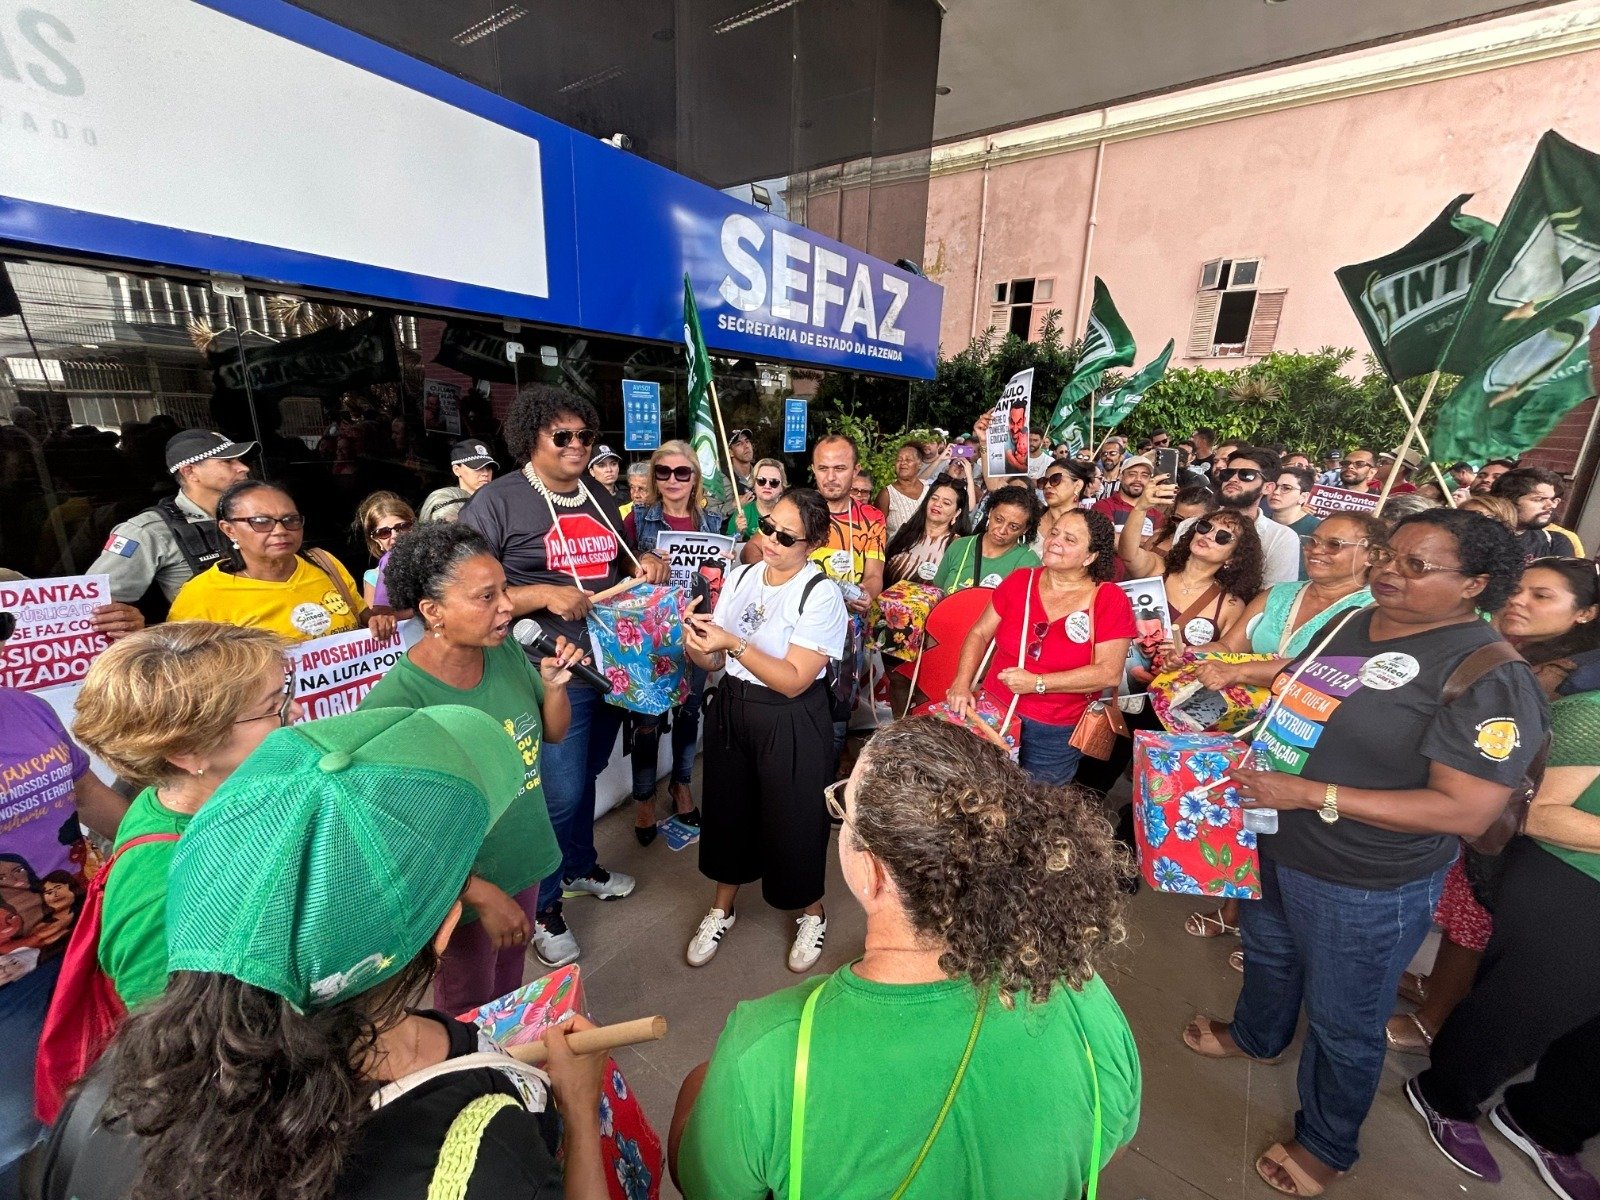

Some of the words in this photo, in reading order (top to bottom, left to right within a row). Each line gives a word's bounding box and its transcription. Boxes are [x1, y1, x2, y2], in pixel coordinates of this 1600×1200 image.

[719, 213, 909, 346] SEFAZ
[718, 314, 798, 343] SECRETARIA
[800, 331, 814, 346] DE
[815, 335, 854, 352] ESTADO
[854, 343, 866, 356] DA
[867, 344, 903, 361] FAZENDA
[1316, 489, 1343, 500] Paulo
[577, 535, 615, 553] VENDA
[670, 544, 720, 555] PAULO
[553, 557, 560, 567] A
[588, 551, 615, 563] ESCOLA
[670, 556, 727, 567] ANTAS
[0, 582, 99, 608] DANTAS
[12, 627, 32, 640] SE
[35, 622, 66, 637] FAZ
[69, 619, 91, 632] CO
[300, 673, 330, 691] NA
[333, 661, 371, 683] LUTA
[1305, 660, 1359, 690] USTIÇA
[1368, 660, 1408, 678] Sinteal
[1302, 691, 1331, 714] QUEM
[8, 774, 50, 801] NOSSOS
